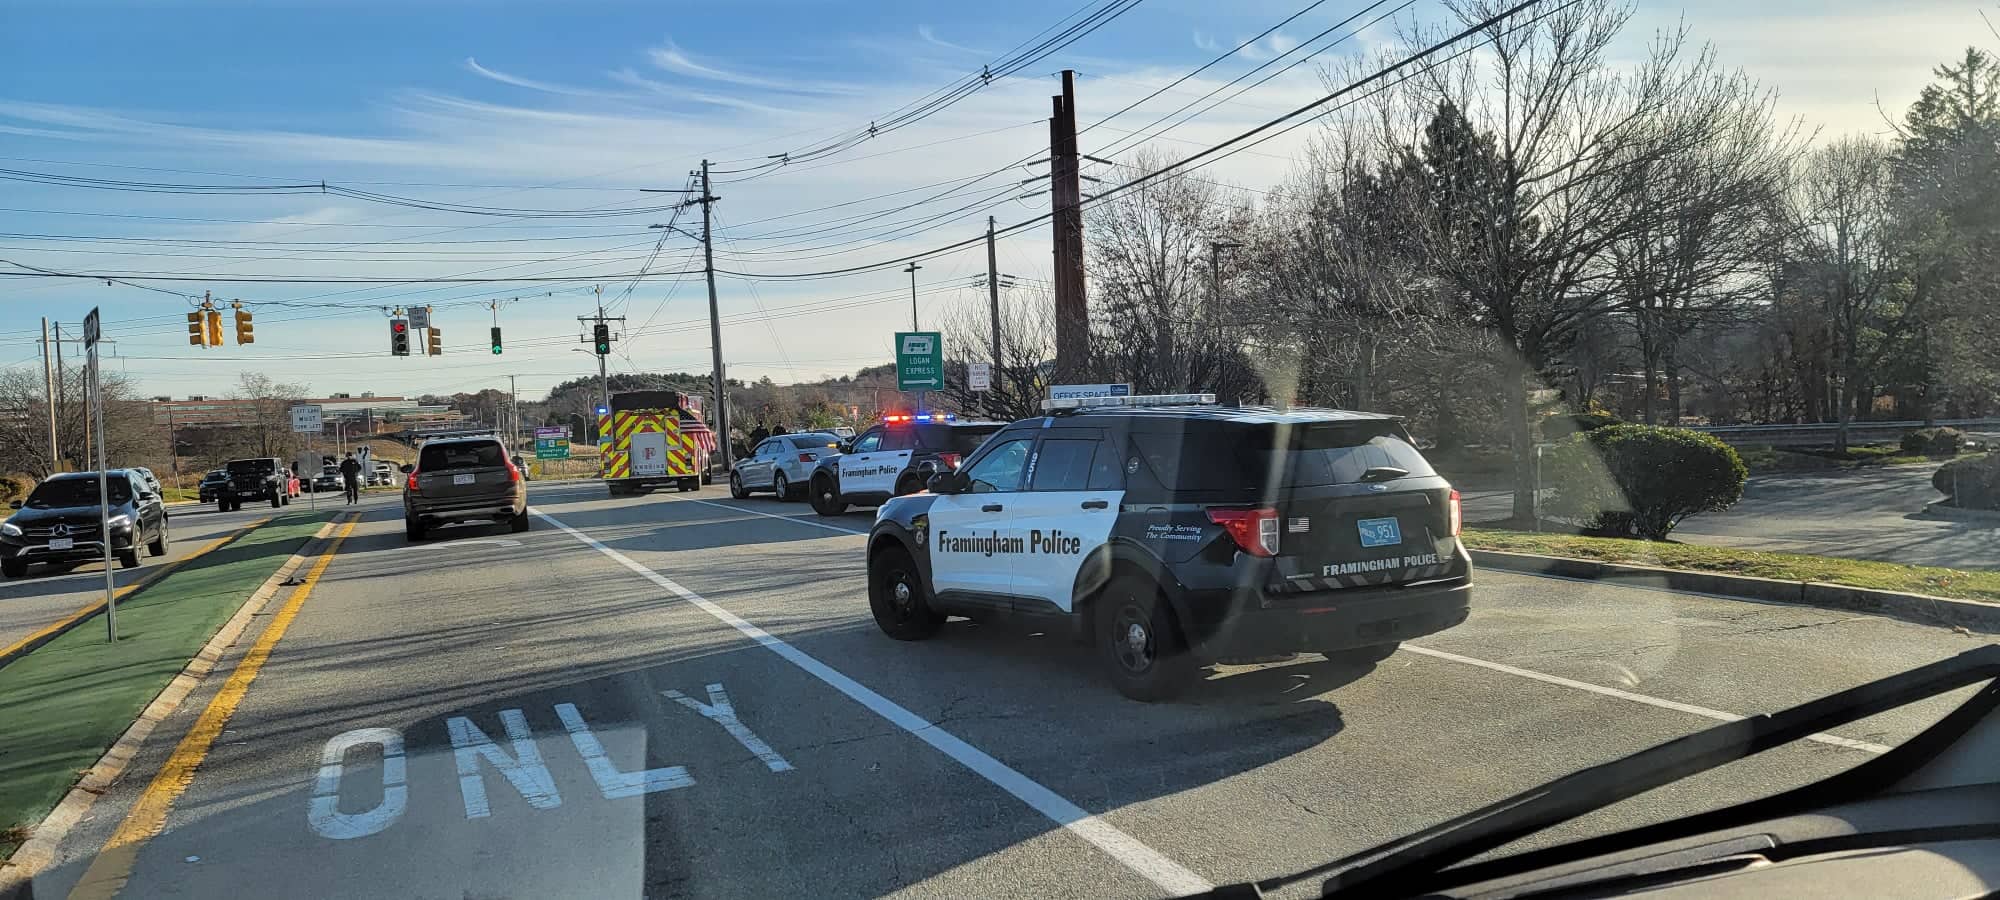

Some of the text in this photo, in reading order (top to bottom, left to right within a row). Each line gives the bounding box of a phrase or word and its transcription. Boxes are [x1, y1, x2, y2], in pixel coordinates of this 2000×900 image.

[909, 357, 930, 365] LOGAN
[905, 367, 935, 375] EXPRESS
[1053, 391, 1081, 399] OFFICE
[842, 465, 898, 478] Framingham Police
[1148, 524, 1202, 534] Proudly Serving
[1377, 524, 1396, 538] 951
[938, 529, 1081, 557] Framingham Police
[1145, 531, 1202, 543] The Community
[1323, 553, 1437, 577] FRAMINGHAM POLICE
[307, 683, 796, 840] ONLY
